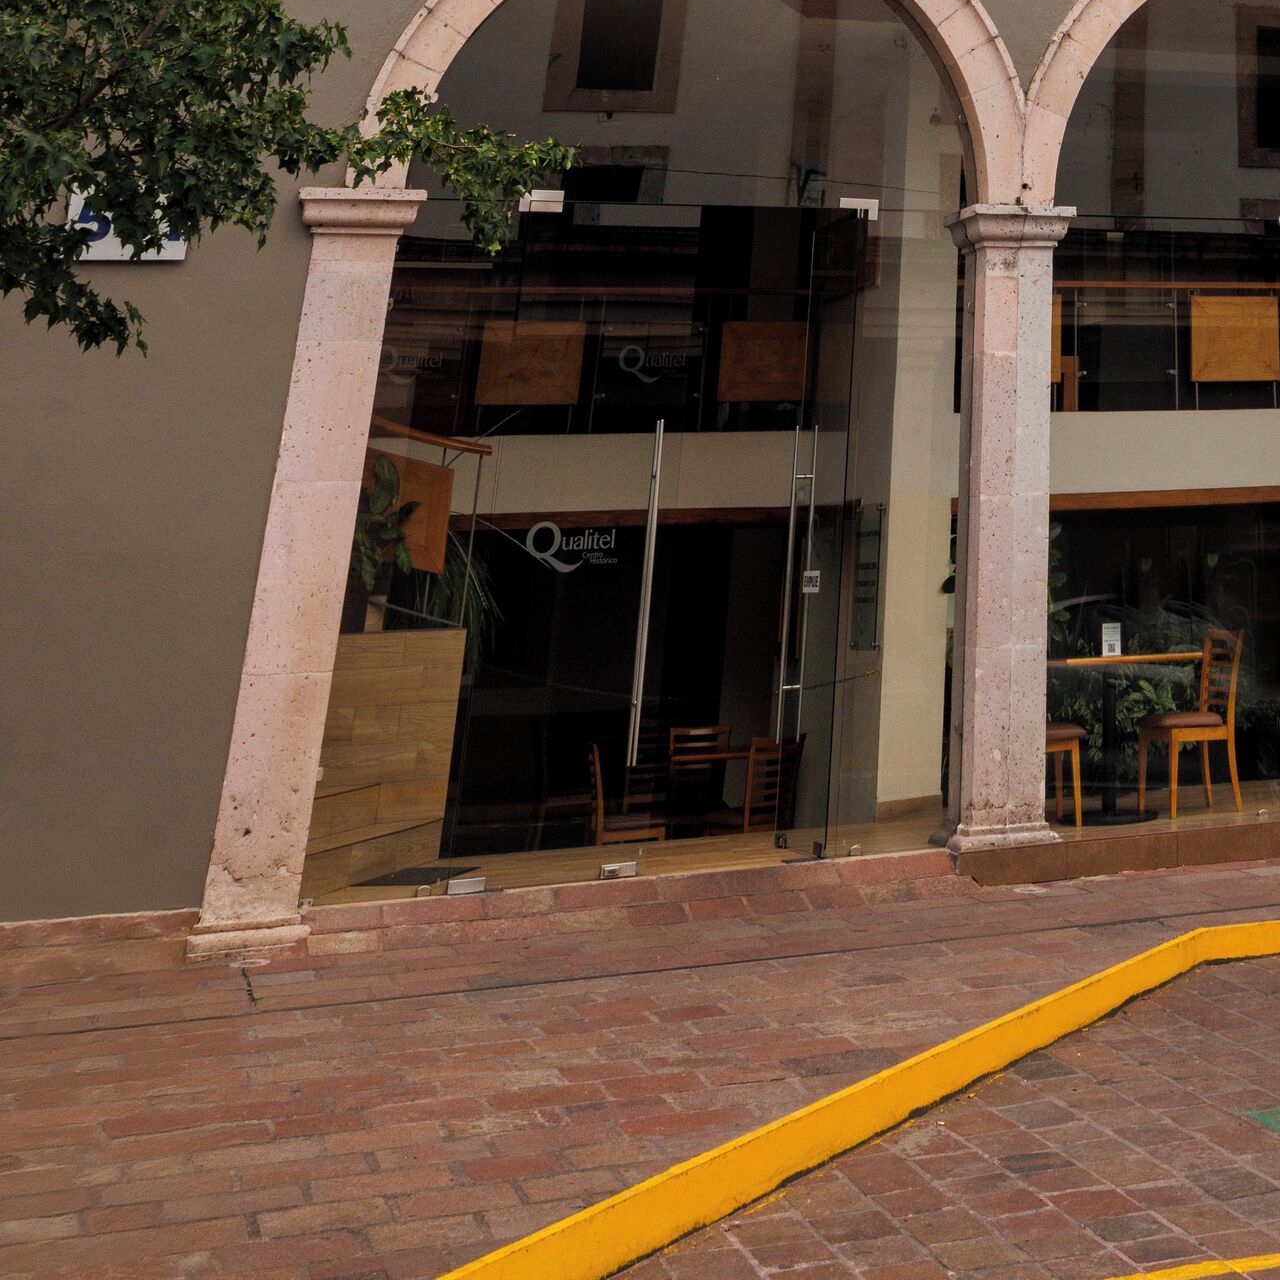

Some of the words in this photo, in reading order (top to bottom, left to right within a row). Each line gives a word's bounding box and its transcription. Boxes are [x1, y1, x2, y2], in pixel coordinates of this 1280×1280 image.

[618, 344, 686, 384] Qualitel
[526, 521, 616, 573] Qualitel
[582, 551, 604, 559] Centro
